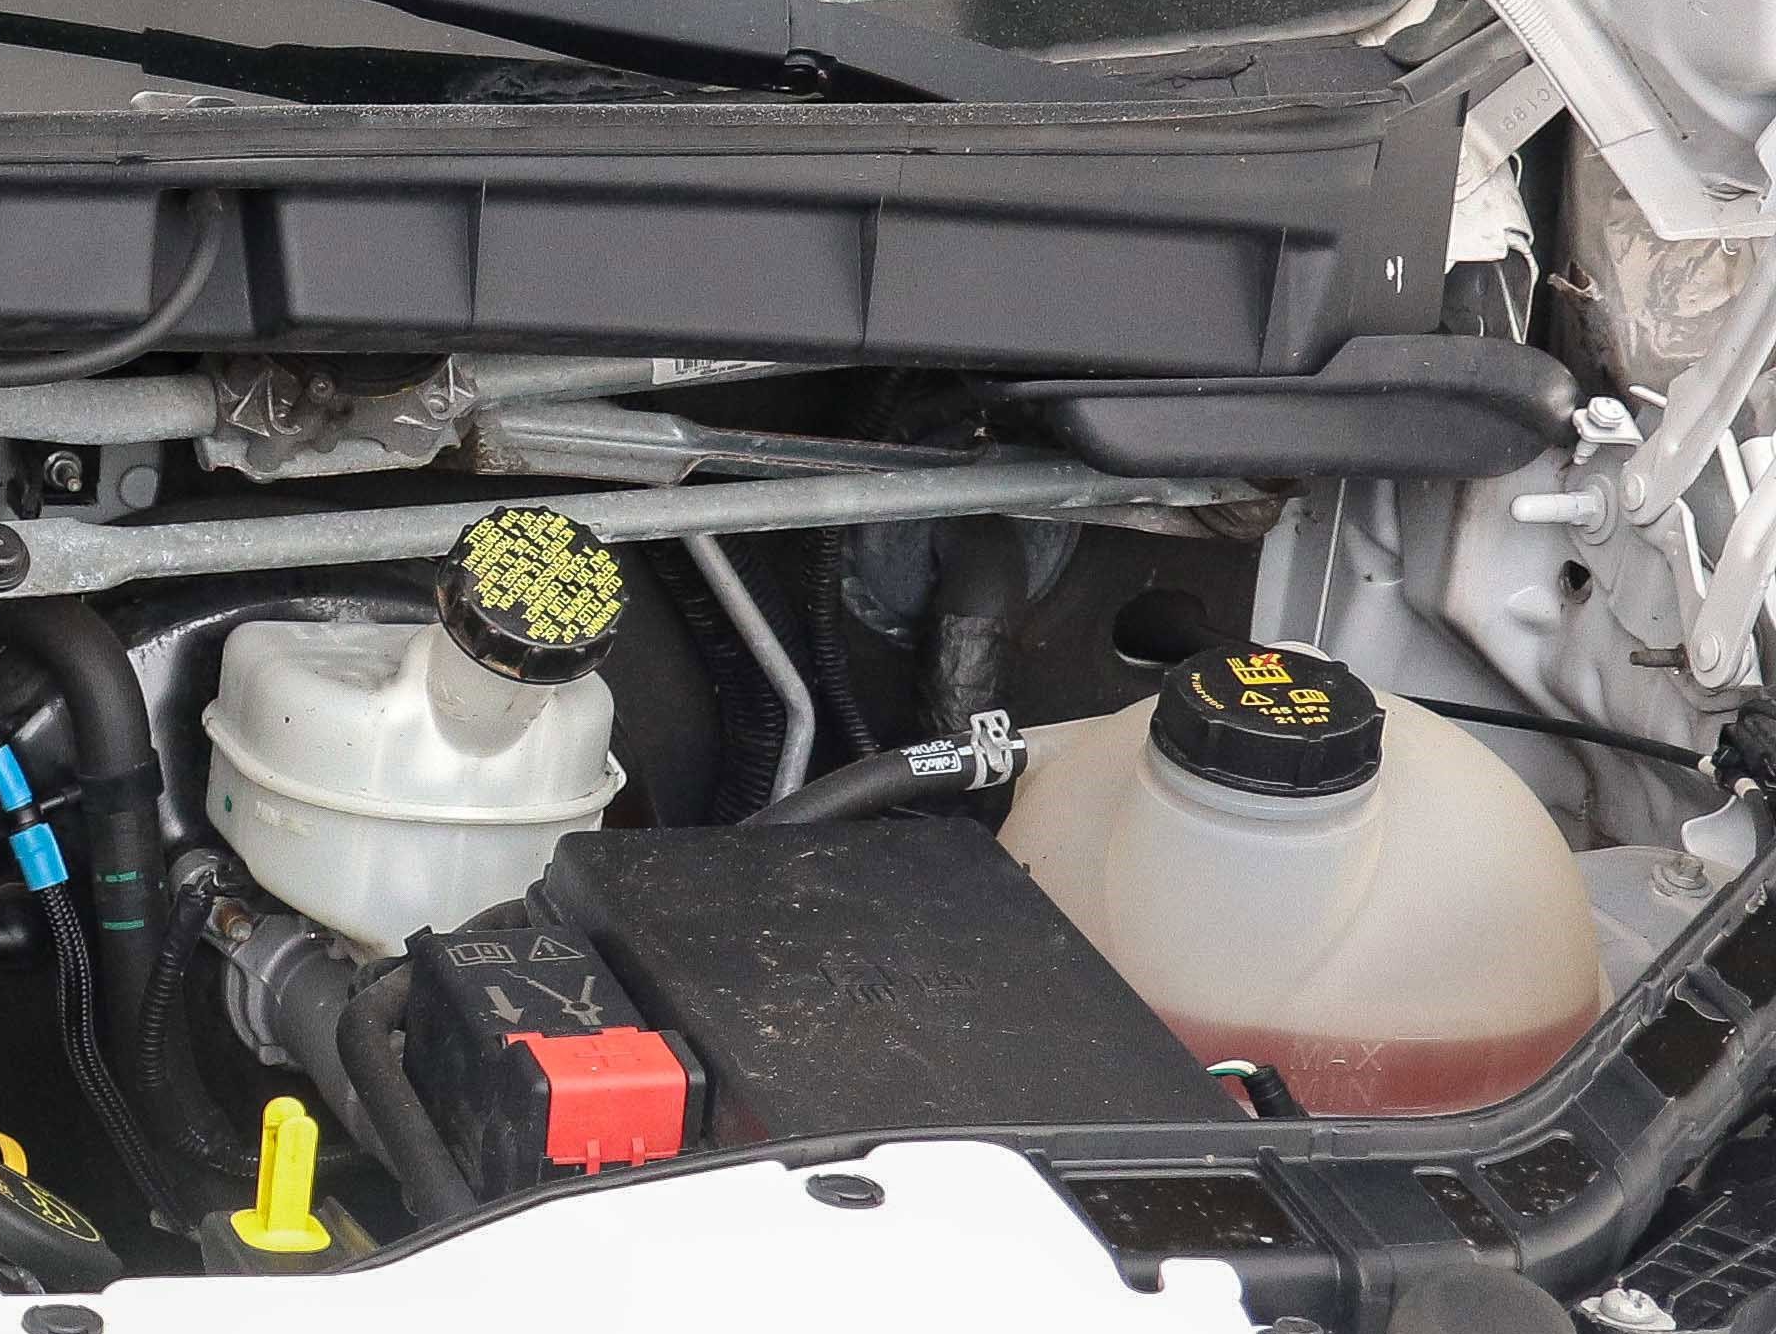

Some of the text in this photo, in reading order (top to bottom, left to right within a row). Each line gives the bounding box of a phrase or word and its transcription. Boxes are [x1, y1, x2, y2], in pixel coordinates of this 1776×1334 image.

[516, 511, 536, 529] DOT
[524, 513, 554, 539] PLOYER
[464, 528, 506, 571] CONTENANT
[509, 538, 530, 555] QUE
[534, 535, 552, 549] DE
[470, 535, 517, 579] PROVENANT
[498, 553, 517, 568] DU
[525, 546, 540, 559] LE
[587, 550, 610, 571] ONLY
[494, 527, 576, 610] NETTOYER LE BOUCHON
[558, 555, 590, 583] SEALED
[572, 568, 596, 587] DOT
[587, 561, 618, 590] BEFORE
[544, 592, 572, 616] FLUID
[573, 599, 603, 625] FILLER
[527, 614, 552, 639] FROM
[540, 625, 563, 642] USE
[558, 624, 582, 643] CAP
[1259, 706, 1330, 715] 145 kPa
[1274, 715, 1329, 725] 21 psi
[913, 756, 957, 771] FoMoCo
[1289, 1042, 1383, 1071] MAX
